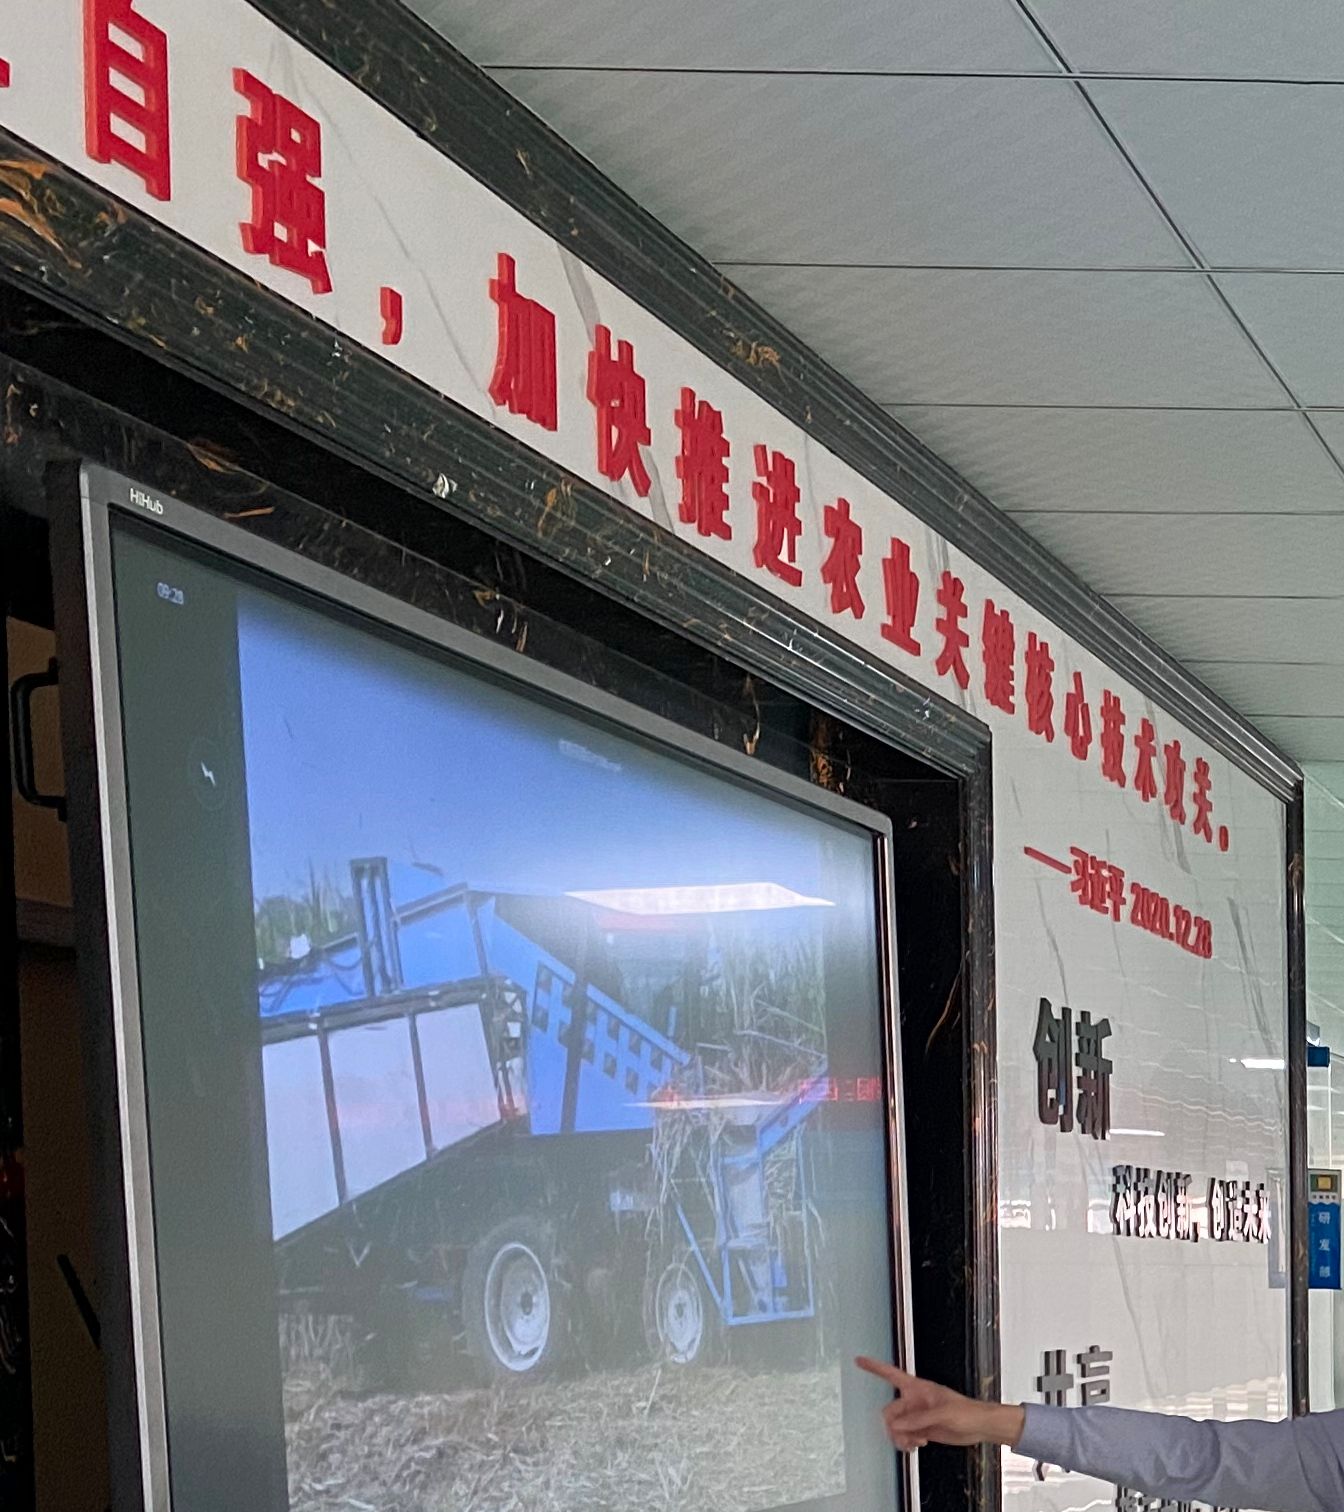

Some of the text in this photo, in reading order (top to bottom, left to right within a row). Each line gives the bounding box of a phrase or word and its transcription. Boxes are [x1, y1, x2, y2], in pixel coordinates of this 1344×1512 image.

[0, 0, 1229, 852] 自强，加快推进农业关键核心技术攻关。
[130, 488, 164, 515] HiHub
[1131, 882, 1212, 959] 2020.12.28
[1033, 997, 1113, 1140] 创新
